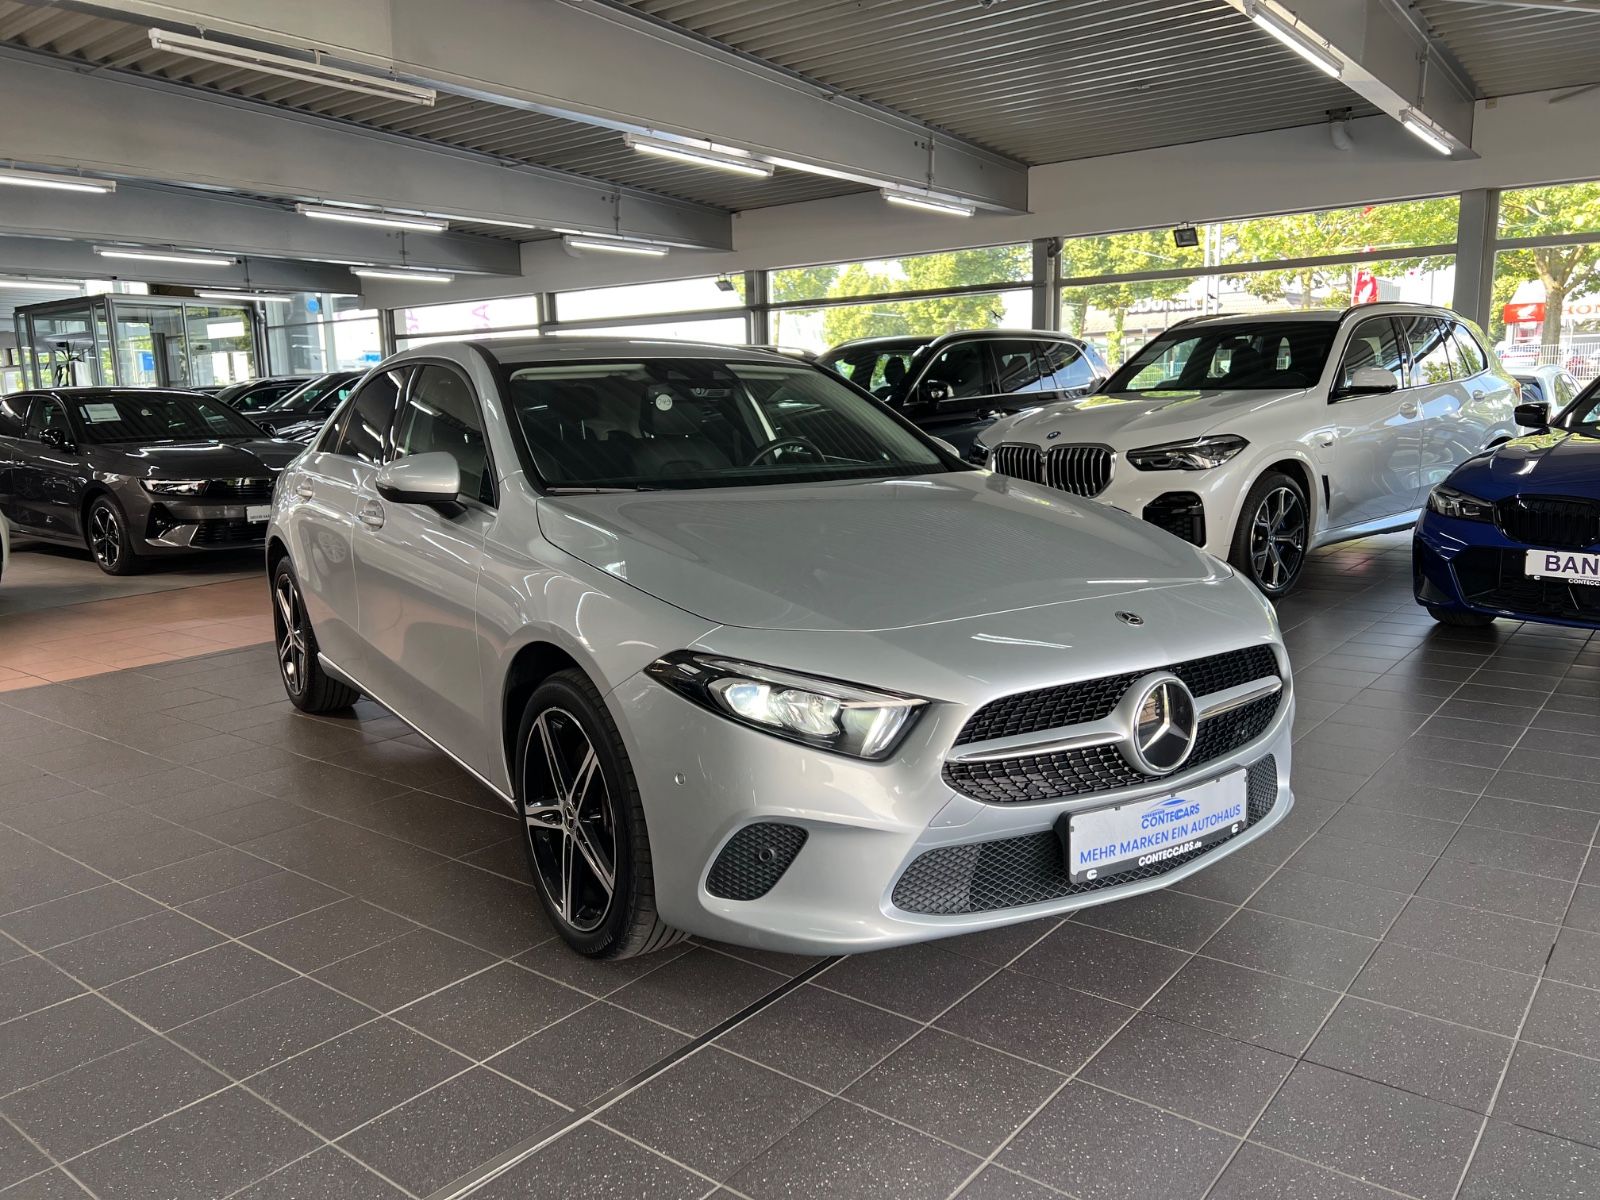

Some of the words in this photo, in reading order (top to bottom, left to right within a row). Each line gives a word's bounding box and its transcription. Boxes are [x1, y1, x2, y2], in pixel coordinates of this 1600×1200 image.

[1545, 554, 1599, 575] BAN
[1080, 844, 1116, 864] MEHR
[1119, 830, 1169, 855] MARKEN
[1172, 824, 1188, 839] EIN
[1190, 804, 1241, 833] AUTOHAUS
[1138, 841, 1202, 867] CONTECCARS.de
